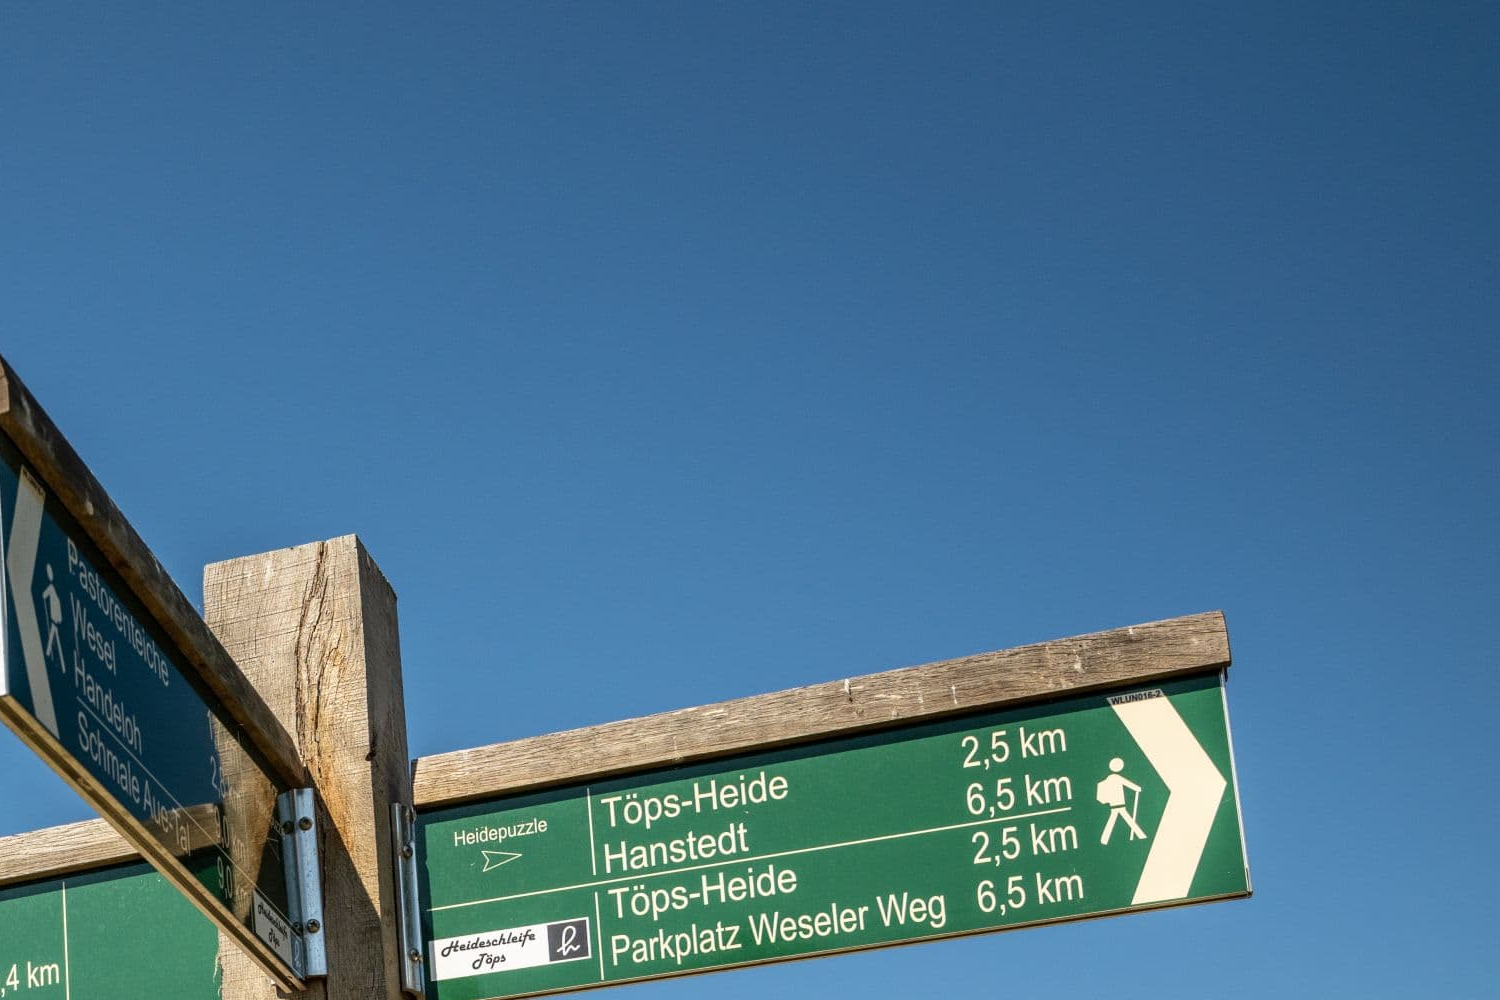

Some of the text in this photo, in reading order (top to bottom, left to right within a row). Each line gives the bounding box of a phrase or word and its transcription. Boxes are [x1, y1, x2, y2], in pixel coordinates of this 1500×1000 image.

[67, 537, 169, 687] Pastorenteiche
[70, 592, 116, 676] Wesel
[210, 755, 226, 800] 2,8
[74, 650, 142, 755] Handeloh
[214, 806, 230, 849] 9,0
[600, 726, 1067, 830] Töps-Heide 2,5 km
[77, 711, 140, 804] Schmale
[143, 779, 191, 857] Aue-Tal
[216, 856, 233, 900] 9,0
[454, 817, 548, 847] Heidepuzzle
[603, 774, 1073, 874] Hanstedt 6,5 km
[607, 823, 1078, 922] Töps-Heide 2,5 km
[610, 871, 1084, 966] Parkplatz Weseler Weg 6,5 km
[27, 961, 60, 989] km
[441, 928, 536, 957] Heideschleife
[471, 952, 506, 970] Töps
